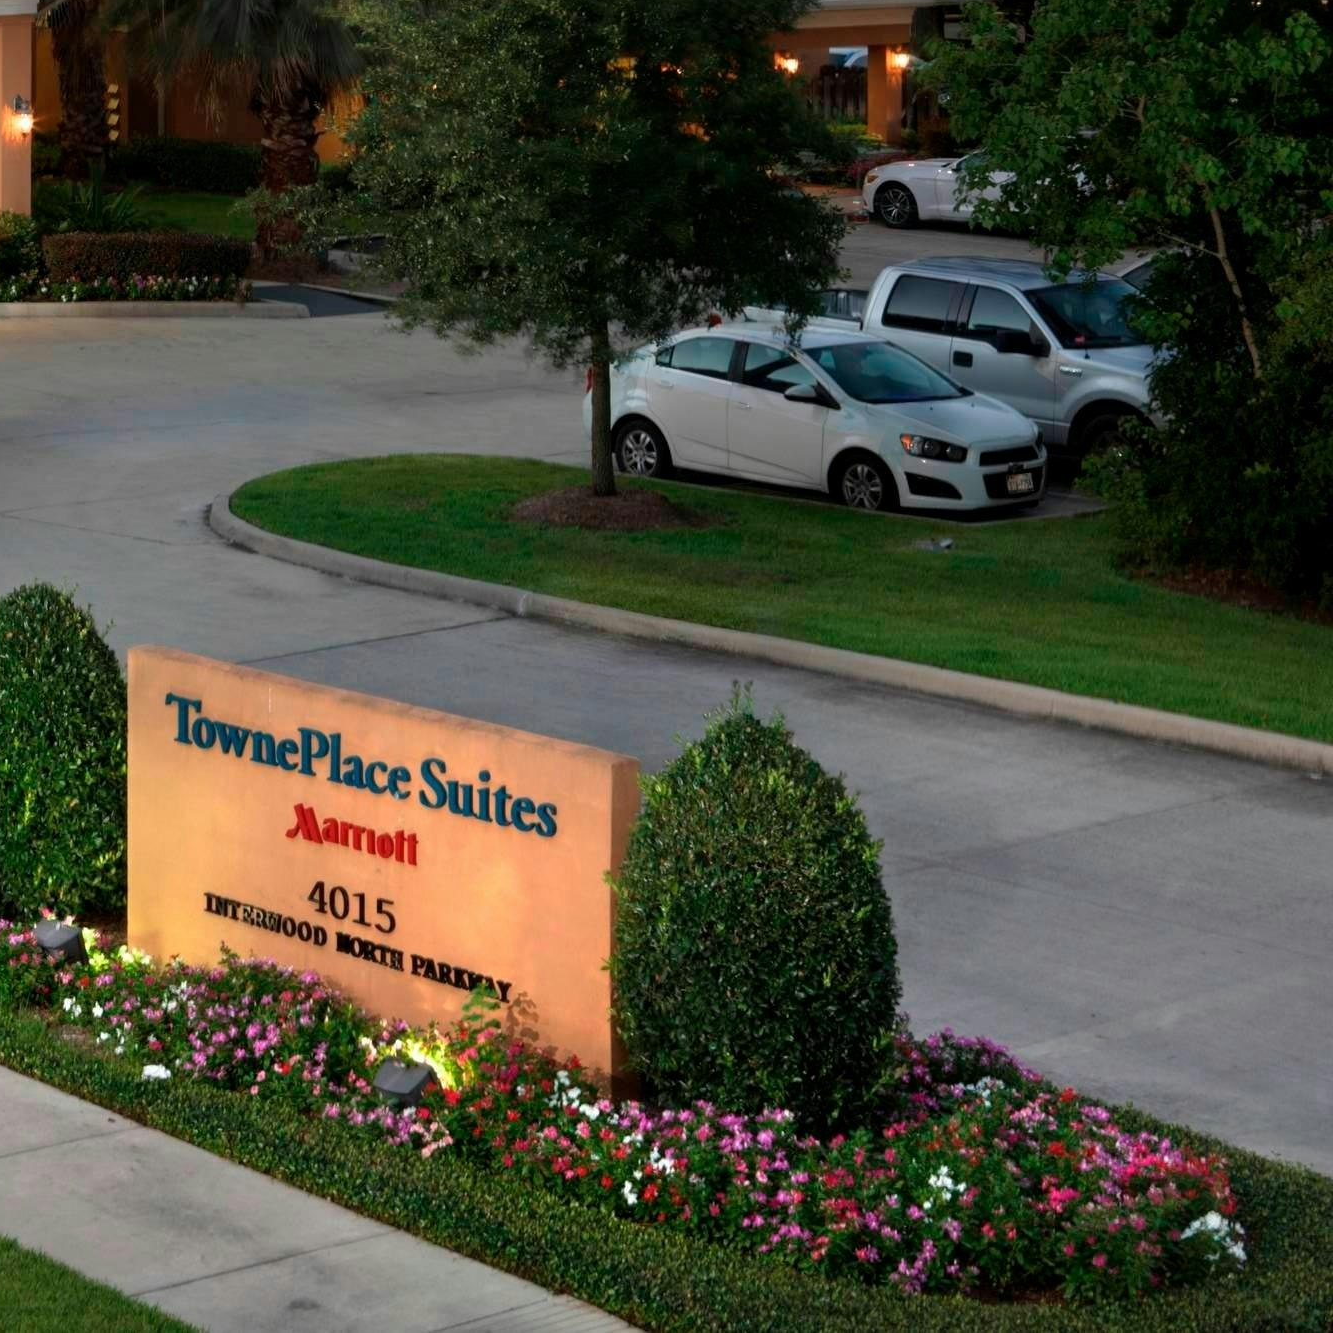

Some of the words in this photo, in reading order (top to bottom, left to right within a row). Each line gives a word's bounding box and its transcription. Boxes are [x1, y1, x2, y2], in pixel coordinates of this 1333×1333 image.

[165, 692, 412, 800] TownePlace
[418, 757, 558, 837] Suites
[285, 802, 420, 866] Marriott
[203, 892, 328, 947] INTERWOOD
[335, 931, 405, 973] NORTH
[307, 880, 397, 934] 4015
